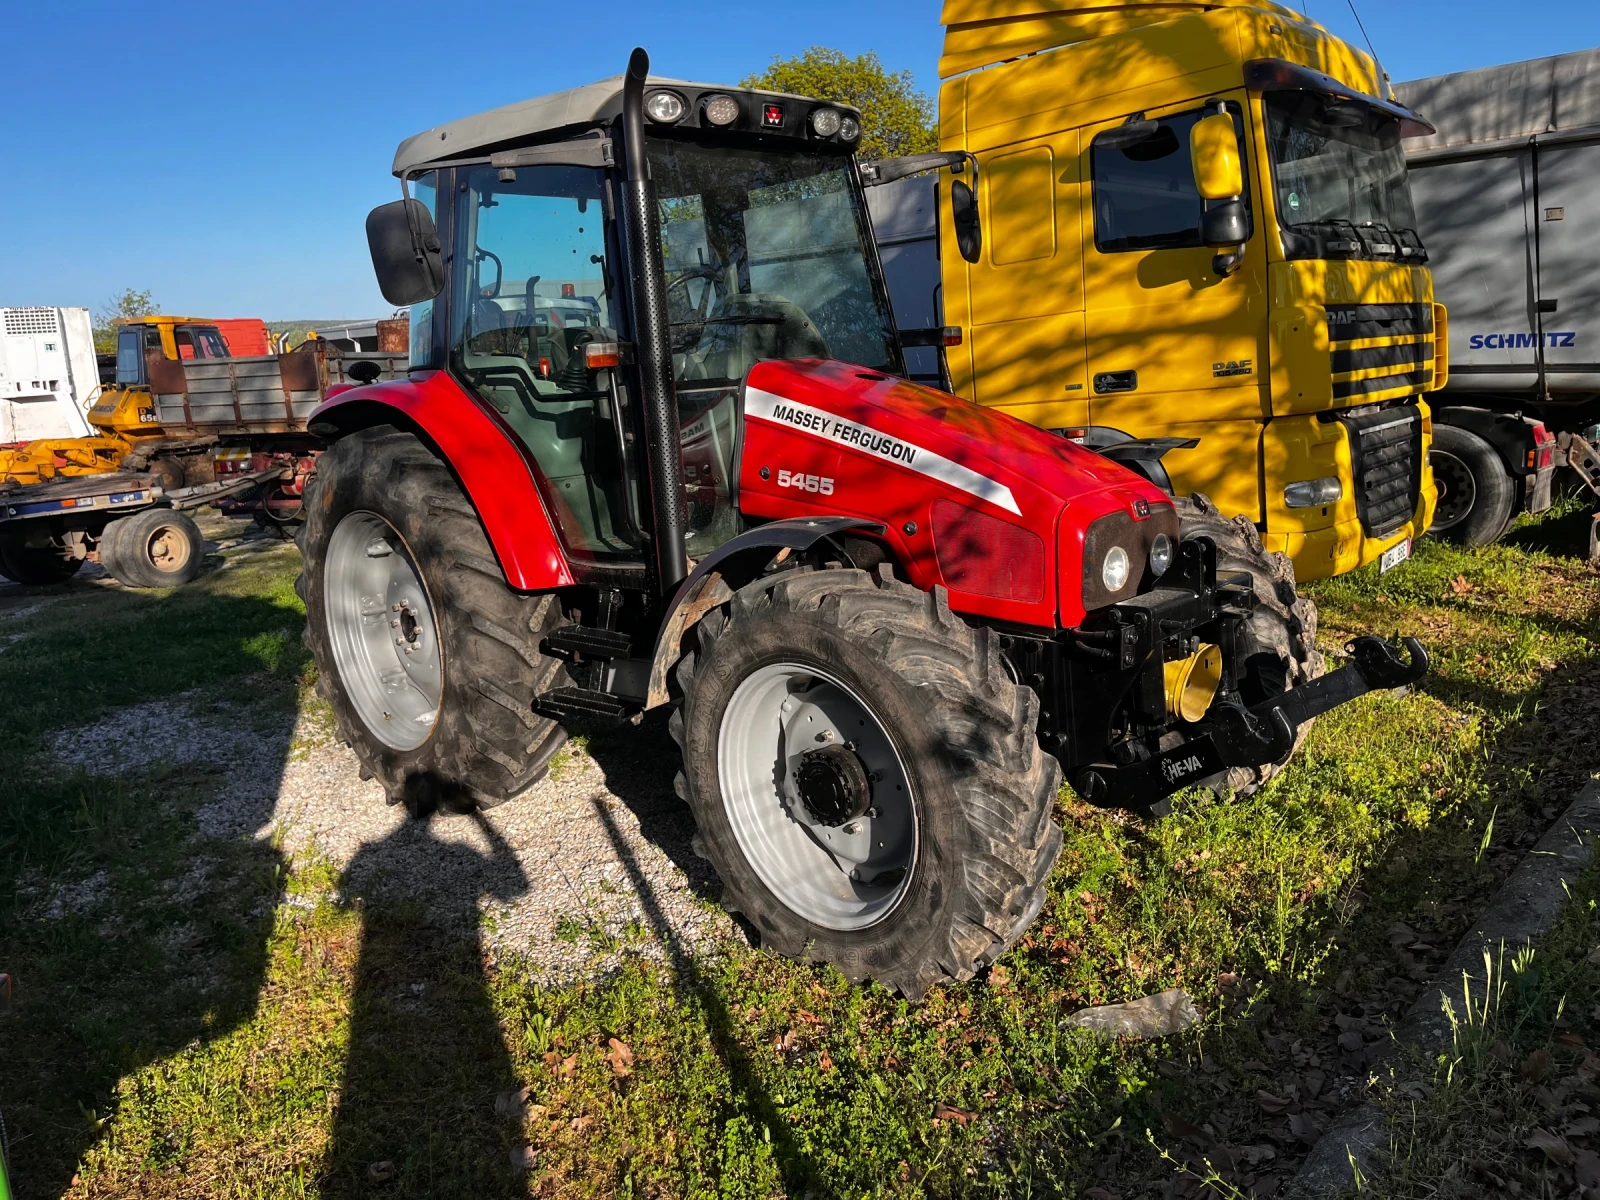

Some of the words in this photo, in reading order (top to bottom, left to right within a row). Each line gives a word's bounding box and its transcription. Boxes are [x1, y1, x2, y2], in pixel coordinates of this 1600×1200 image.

[1469, 331, 1576, 350] SCHMITZ
[1212, 359, 1252, 370] DAF
[772, 403, 831, 434] MASSEY
[832, 422, 917, 465] FERGUSON
[777, 470, 835, 497] 5455
[1167, 754, 1203, 778] HE-VA
